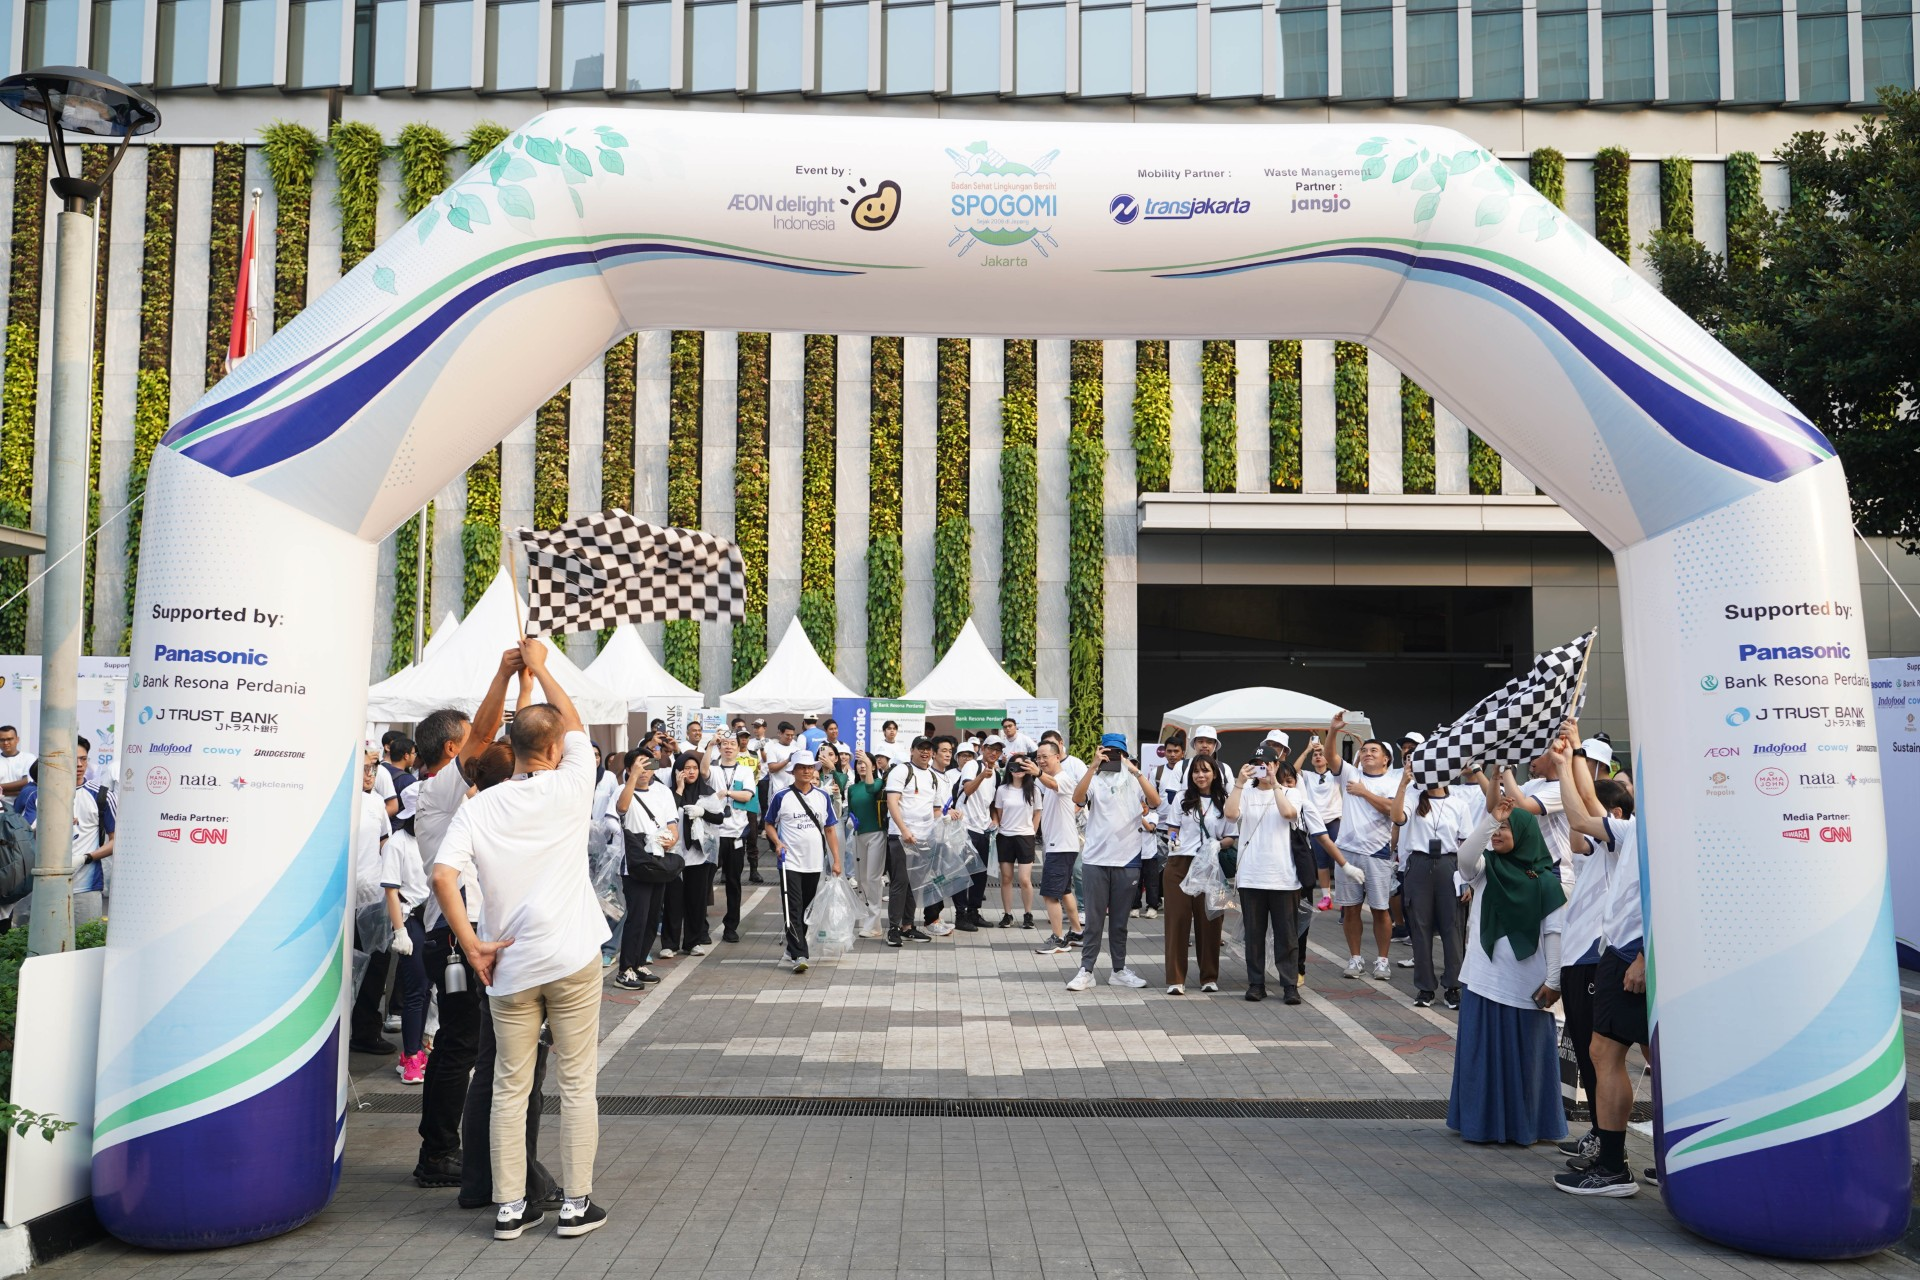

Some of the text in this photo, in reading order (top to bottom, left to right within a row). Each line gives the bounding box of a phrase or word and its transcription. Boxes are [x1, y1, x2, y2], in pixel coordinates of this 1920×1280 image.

[795, 166, 828, 175] Event
[832, 166, 845, 177] by
[1137, 169, 1181, 180] Mobility
[1184, 169, 1225, 178] Partner
[1264, 167, 1372, 178] Waste Management
[994, 182, 1032, 191] Lingkungan
[1296, 182, 1335, 191] Partner
[776, 196, 835, 216] delight
[952, 194, 1057, 216] SPOGOMI
[1144, 197, 1250, 217] transjakarta
[1290, 194, 1351, 213] jangjo
[774, 215, 835, 230] Indonesia
[981, 256, 1028, 267] Jakarta
[152, 604, 284, 627] Supported by:
[1725, 601, 1852, 621] Supported by:
[154, 644, 268, 666] Panasonic
[1739, 642, 1850, 661] Panasonic
[143, 674, 306, 695] Bank Resona Perdania
[1725, 673, 1870, 689] Bank Resona Perdania
[1878, 696, 1906, 708] Indofood
[156, 709, 278, 724] J TRUST BANK
[1756, 706, 1865, 720] J TRUST BANK
[149, 743, 192, 756] Indofood
[203, 747, 241, 756] coway
[254, 749, 306, 759] BRIDGESTONE
[1752, 743, 1807, 756] Indofood
[250, 780, 304, 790] agkcleaning
[160, 813, 229, 822] Media Partner:
[190, 828, 228, 844] CNN
[1820, 826, 1852, 842] CNN
